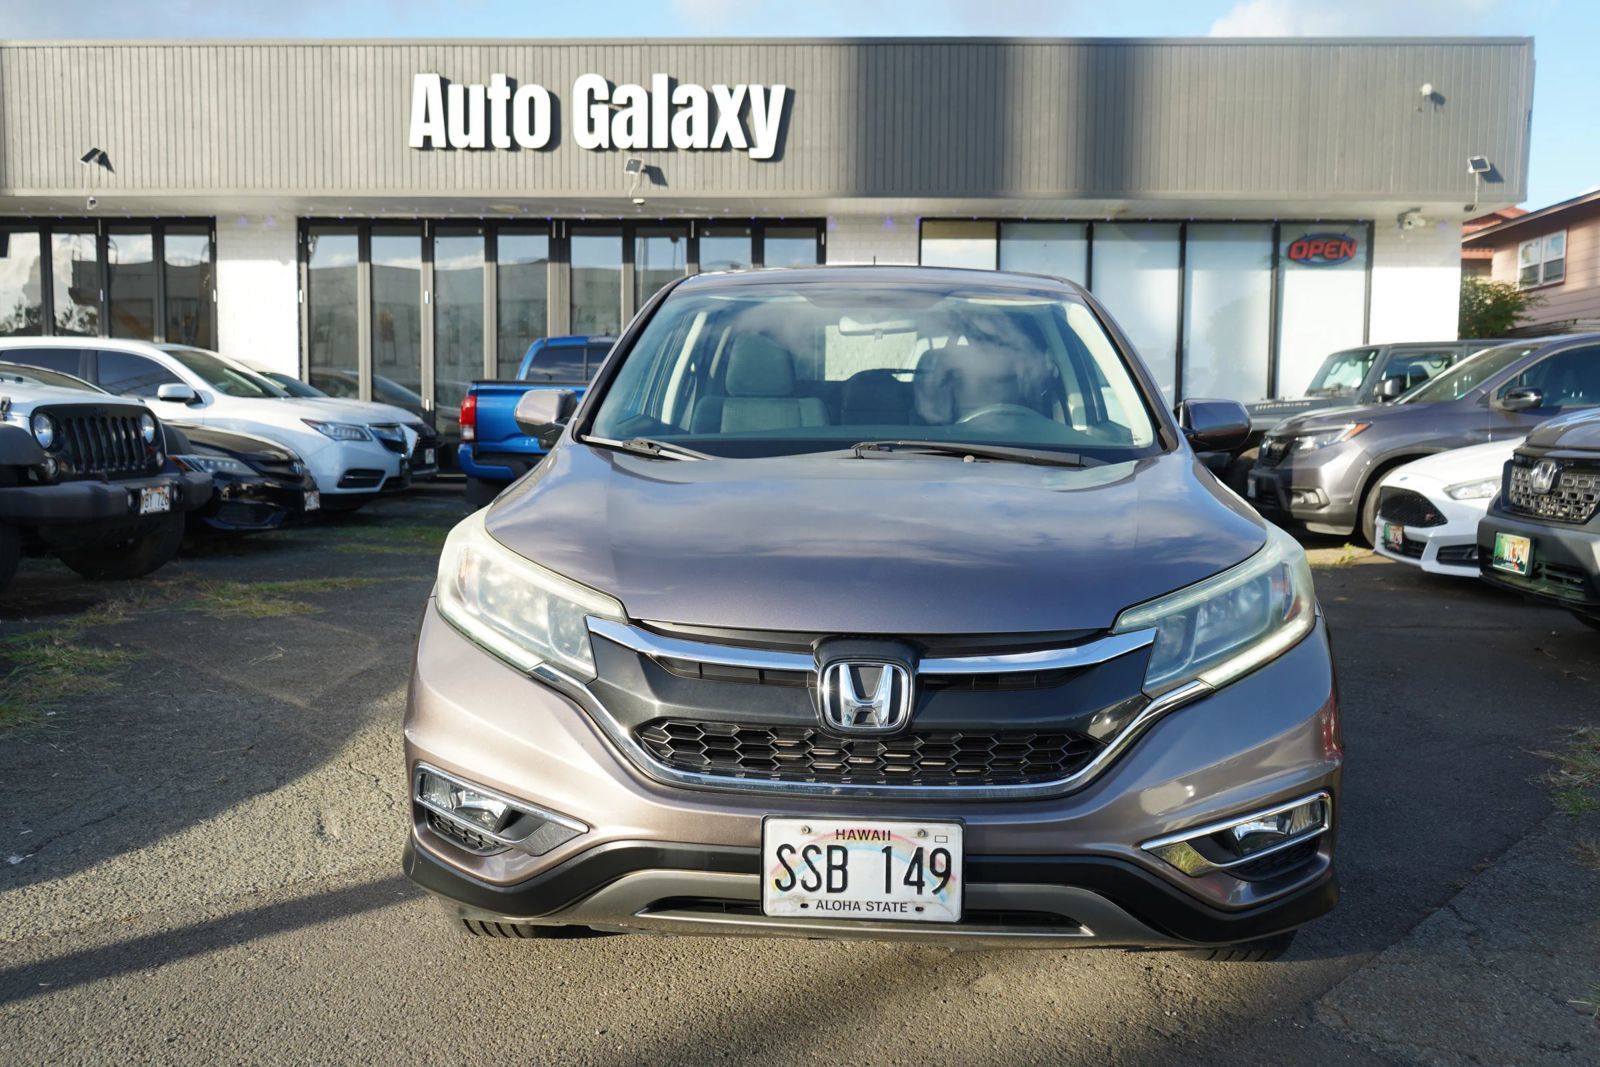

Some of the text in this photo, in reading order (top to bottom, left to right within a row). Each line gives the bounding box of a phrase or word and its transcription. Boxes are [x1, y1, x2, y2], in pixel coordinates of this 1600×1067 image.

[409, 73, 788, 160] Auto Galaxy
[1289, 240, 1358, 260] OPEN
[835, 829, 892, 841] HAWAII
[774, 843, 952, 895] SSB 149
[815, 899, 908, 913] ALOHA STATE
